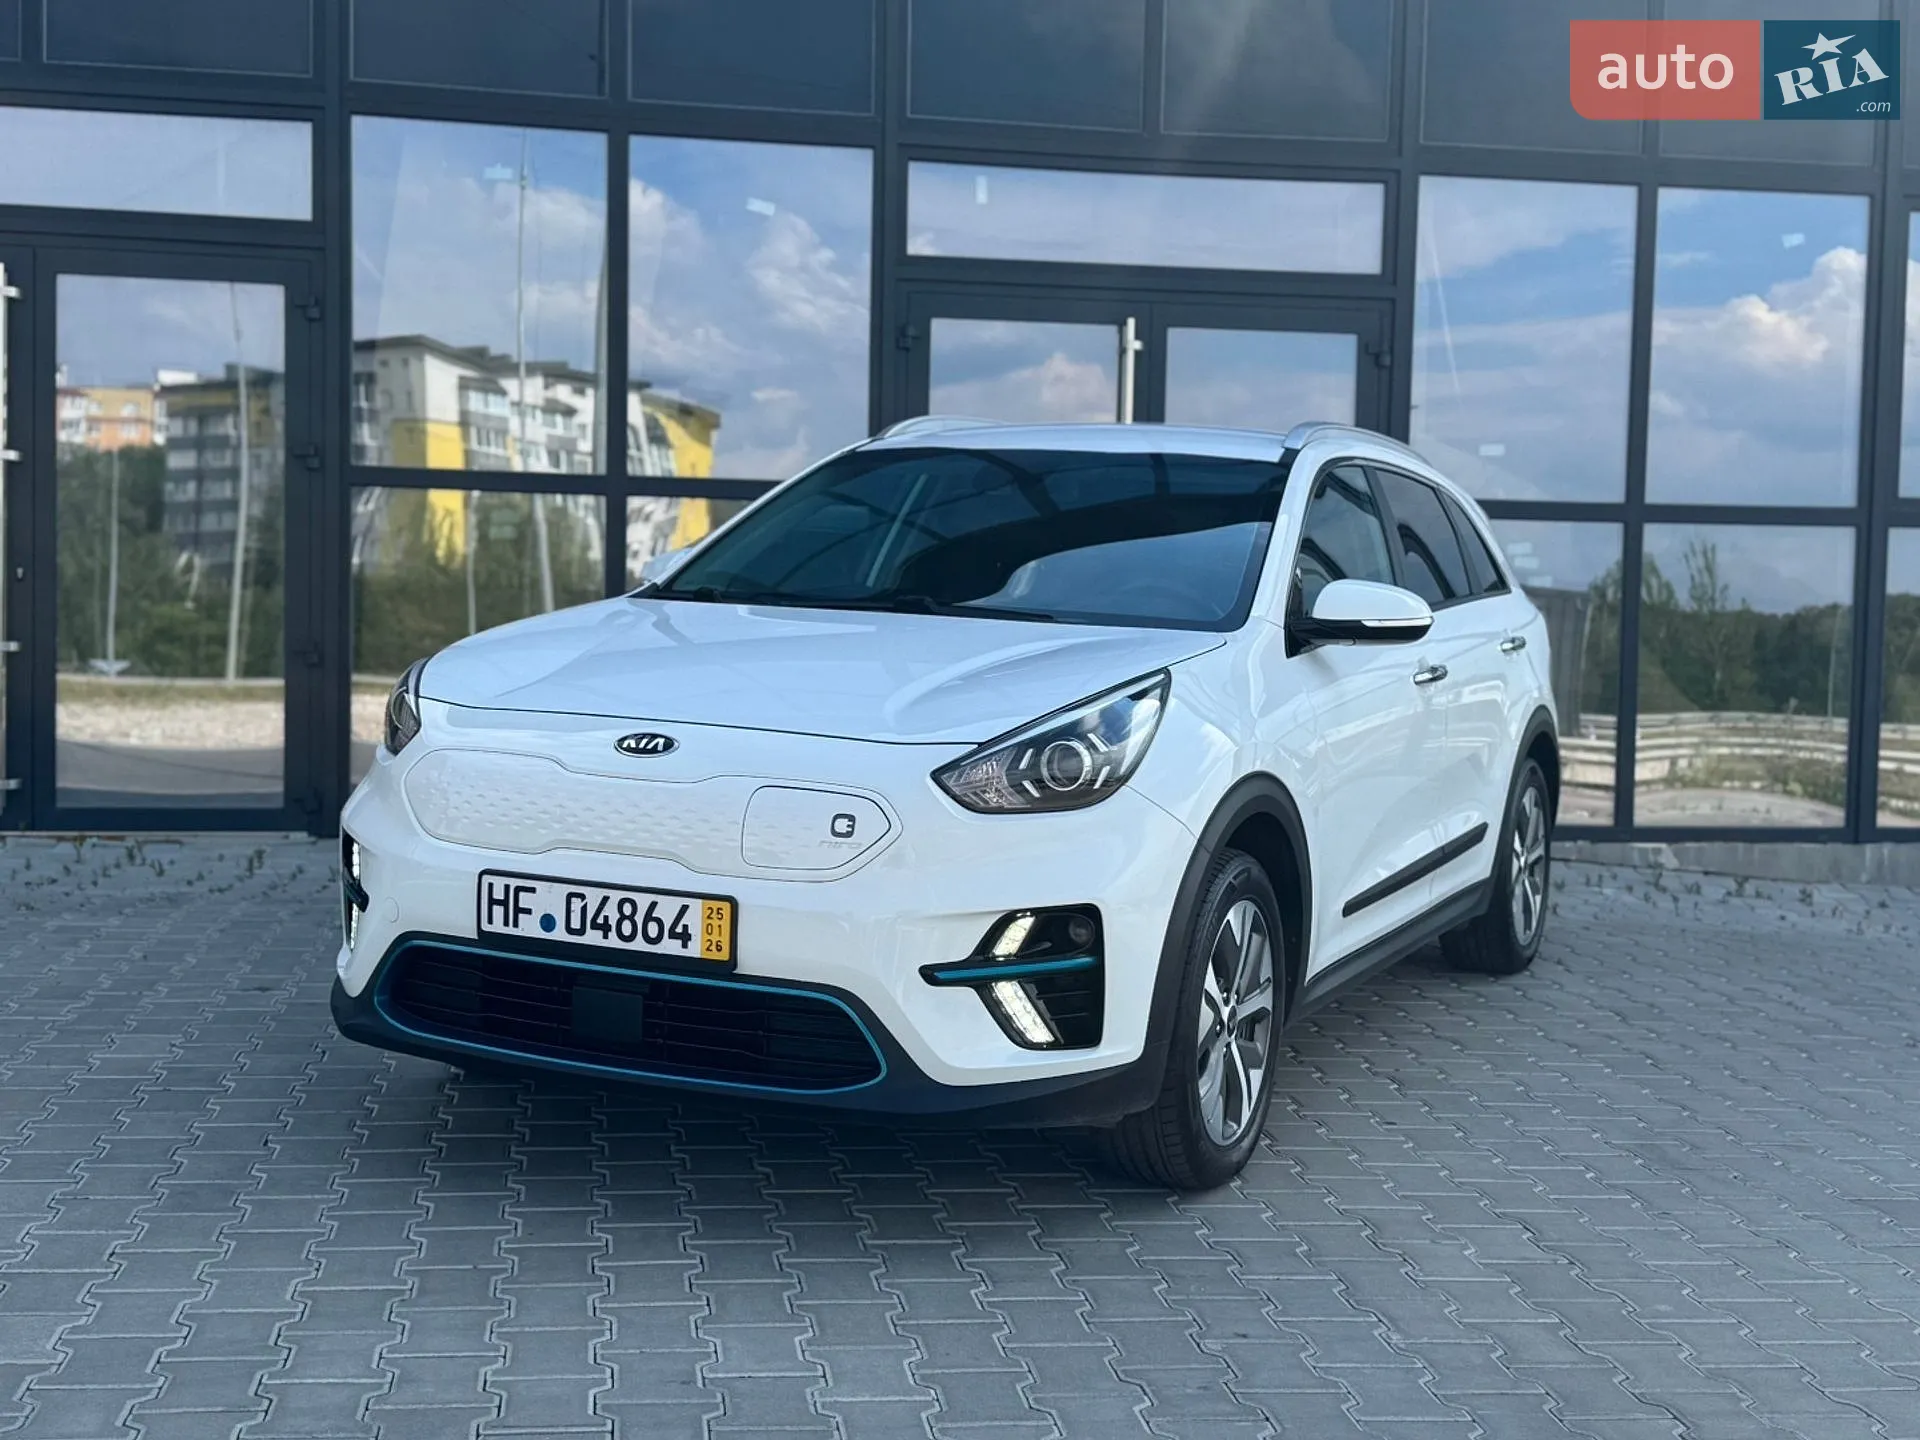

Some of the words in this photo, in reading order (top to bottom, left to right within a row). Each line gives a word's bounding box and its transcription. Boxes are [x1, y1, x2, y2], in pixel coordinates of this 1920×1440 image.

[621, 735, 666, 752] KIA
[486, 882, 537, 929] HF
[564, 891, 693, 950] 04864
[706, 906, 725, 921] 25
[705, 923, 723, 937] 01
[705, 939, 724, 953] 26
